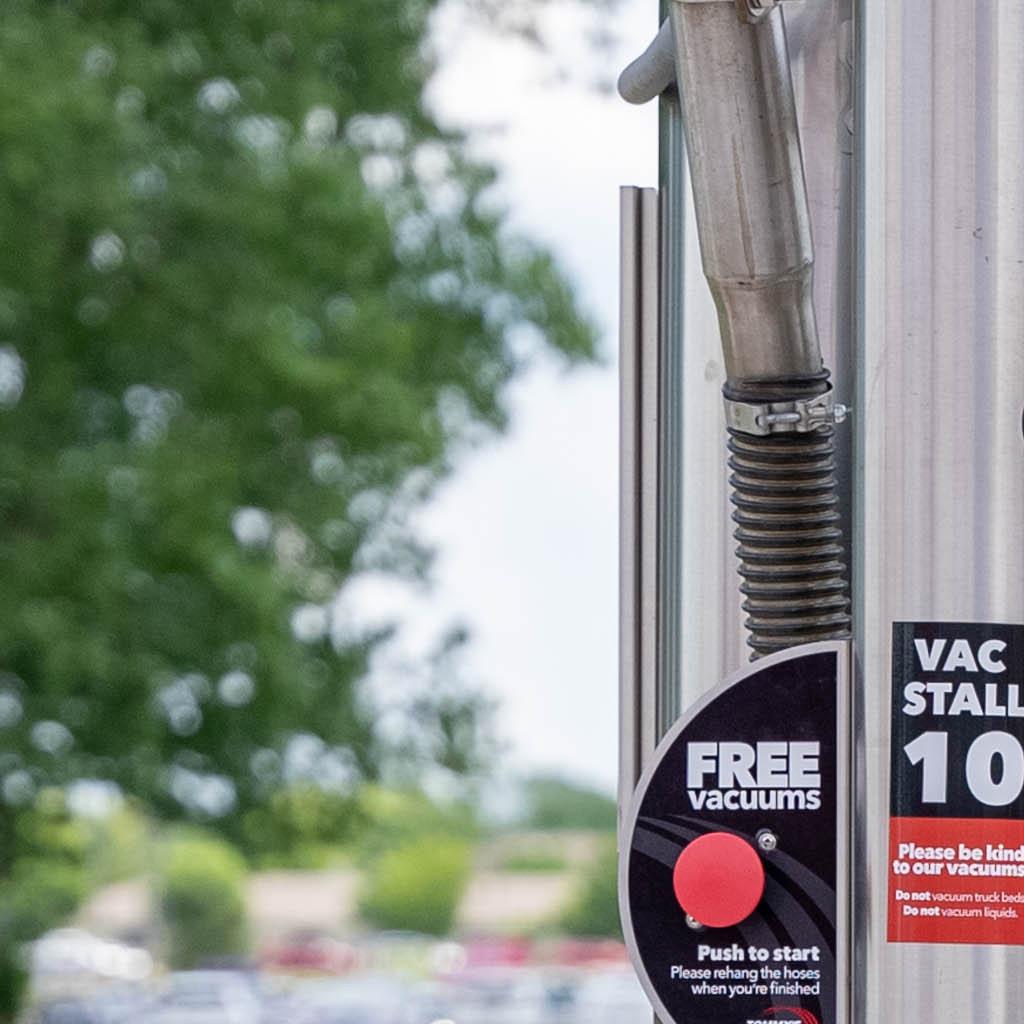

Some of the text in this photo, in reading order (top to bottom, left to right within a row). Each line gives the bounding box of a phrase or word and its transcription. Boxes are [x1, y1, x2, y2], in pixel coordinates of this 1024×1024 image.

[914, 639, 1007, 674] VAC
[687, 741, 821, 788] FREE
[687, 789, 821, 810] vacuums
[899, 843, 956, 860] Please
[958, 844, 983, 861] be
[893, 860, 910, 875] to
[912, 862, 944, 876] our
[896, 890, 910, 900] Do
[912, 890, 931, 901] not
[932, 893, 974, 902] vacuum
[975, 891, 1000, 902] truck
[904, 905, 1018, 920] Do not vacuum liquids.
[698, 944, 820, 962] Push to start
[671, 965, 820, 983] Please rehang the hoses
[692, 982, 820, 998] when you're finished
